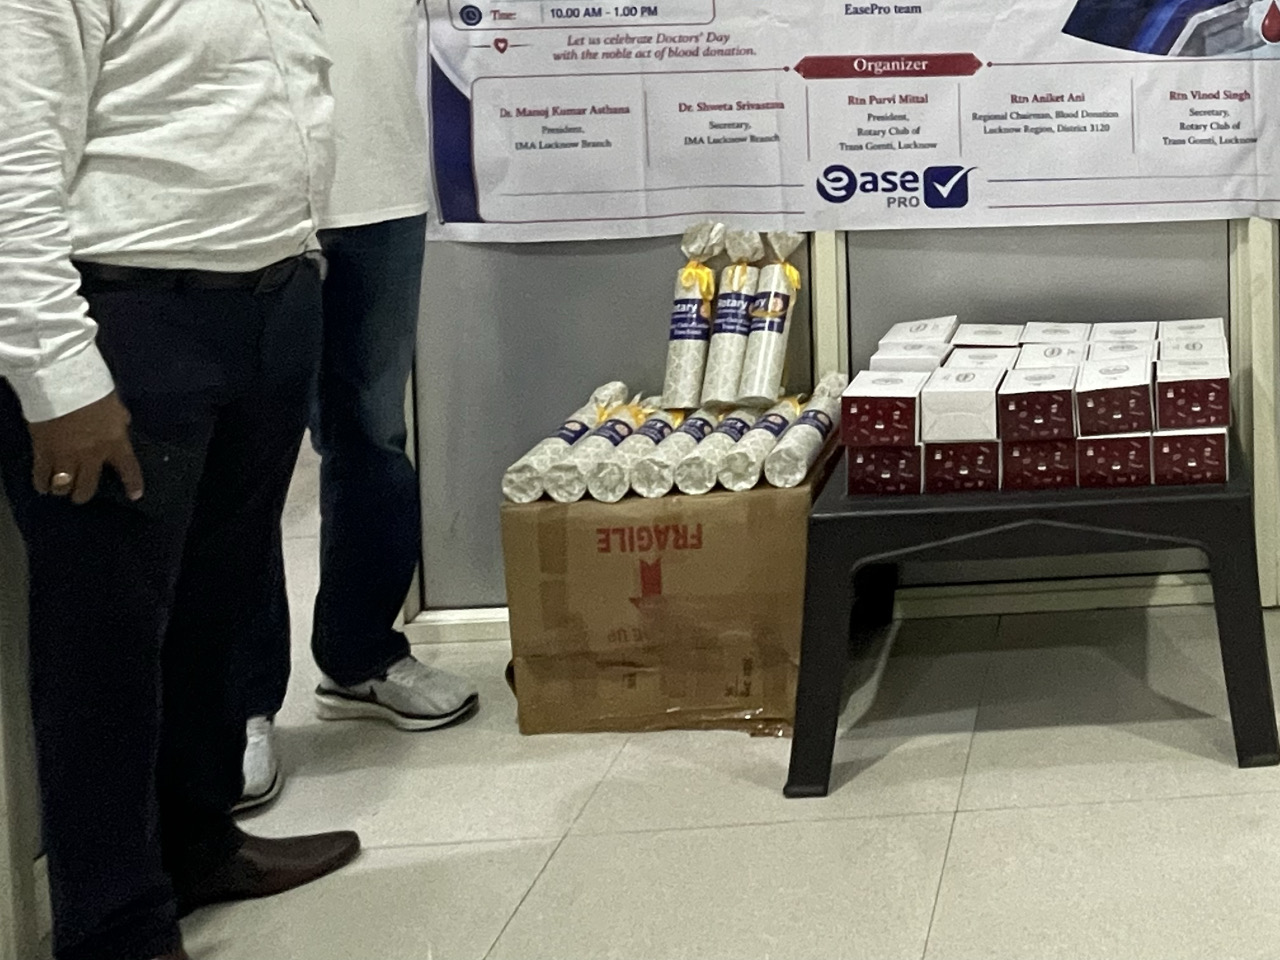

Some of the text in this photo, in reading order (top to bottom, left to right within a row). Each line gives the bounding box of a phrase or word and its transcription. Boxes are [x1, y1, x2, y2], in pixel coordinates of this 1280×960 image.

[550, 8, 580, 18] 10.00
[583, 7, 602, 17] AM
[614, 6, 637, 17] 1.00
[640, 6, 658, 16] PM
[844, 3, 922, 15] EasePro team
[567, 35, 585, 46] Let
[588, 36, 600, 45] us
[603, 34, 653, 45] celebrate
[706, 32, 730, 44] Day
[553, 46, 757, 60] with the noble act of blood donation.
[853, 58, 929, 74] Organizer
[869, 94, 896, 105] Purvi
[1031, 93, 1065, 103] Aniket
[1067, 93, 1086, 102] Ani
[1190, 90, 1221, 100] Vinod
[1223, 90, 1251, 102] Singh
[886, 196, 920, 208] PRO
[595, 522, 704, 554] FRAGILE
